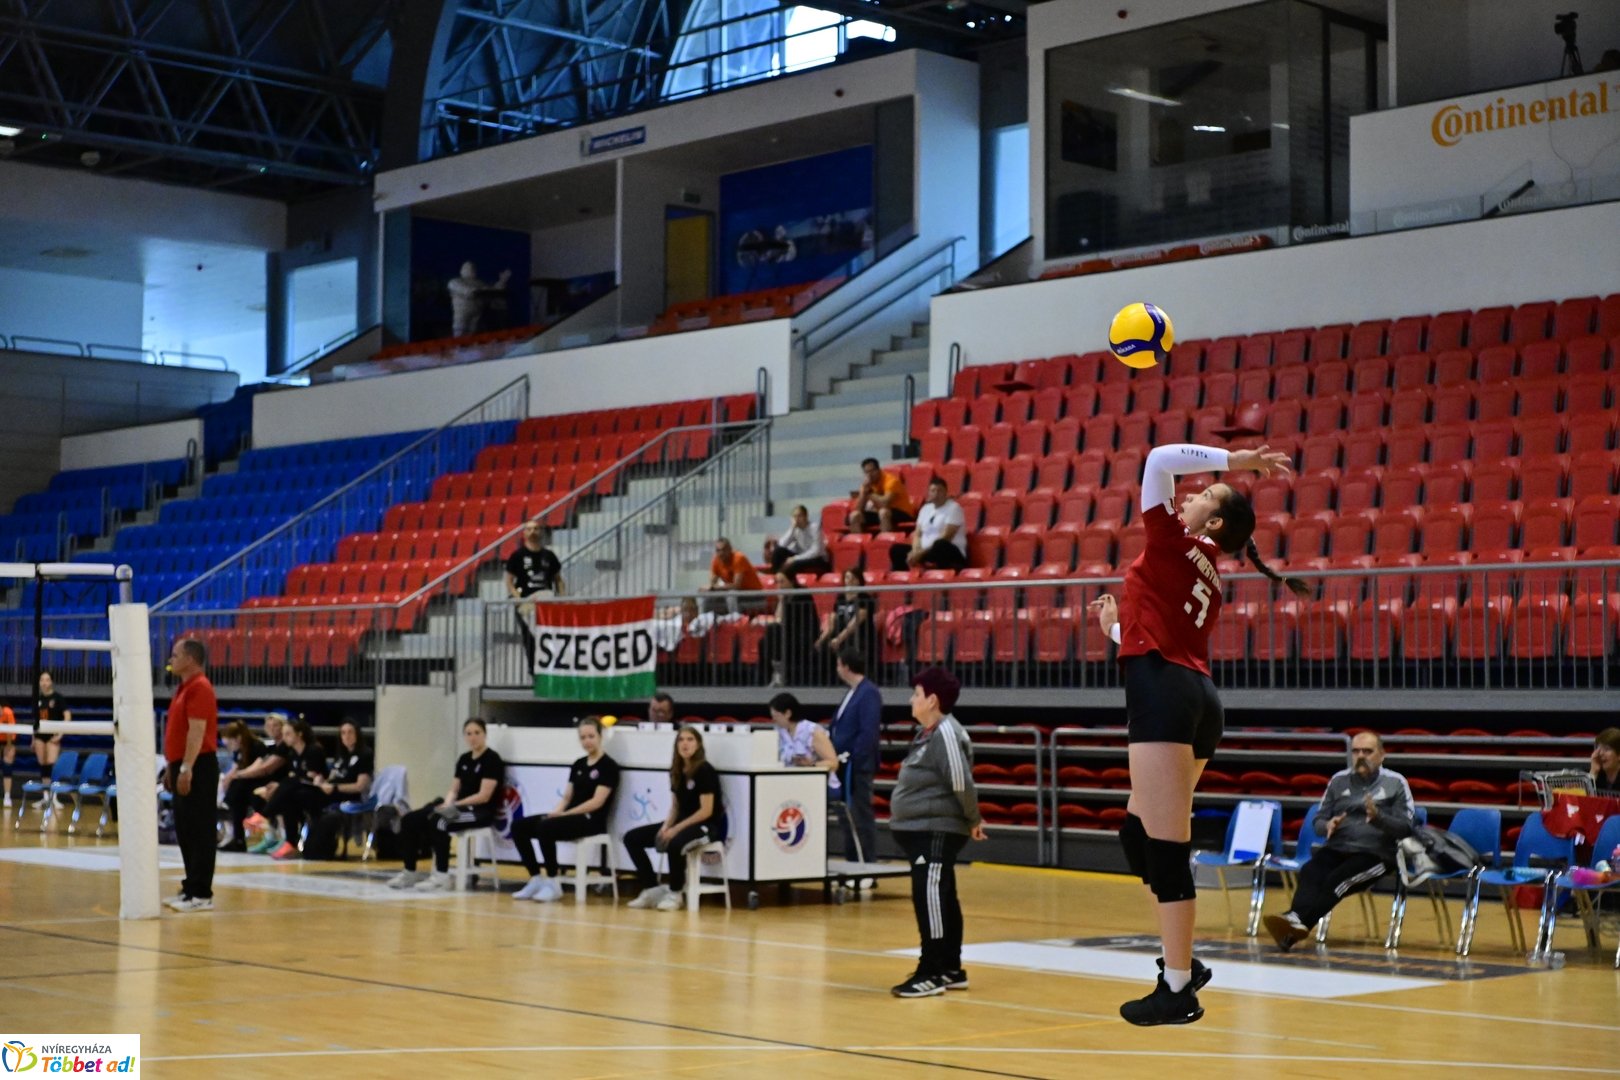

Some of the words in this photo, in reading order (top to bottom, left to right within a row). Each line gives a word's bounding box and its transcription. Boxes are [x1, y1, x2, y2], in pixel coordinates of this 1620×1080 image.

[1431, 80, 1608, 147] Continental
[1184, 577, 1212, 629] 5
[538, 629, 653, 671] SZEGED
